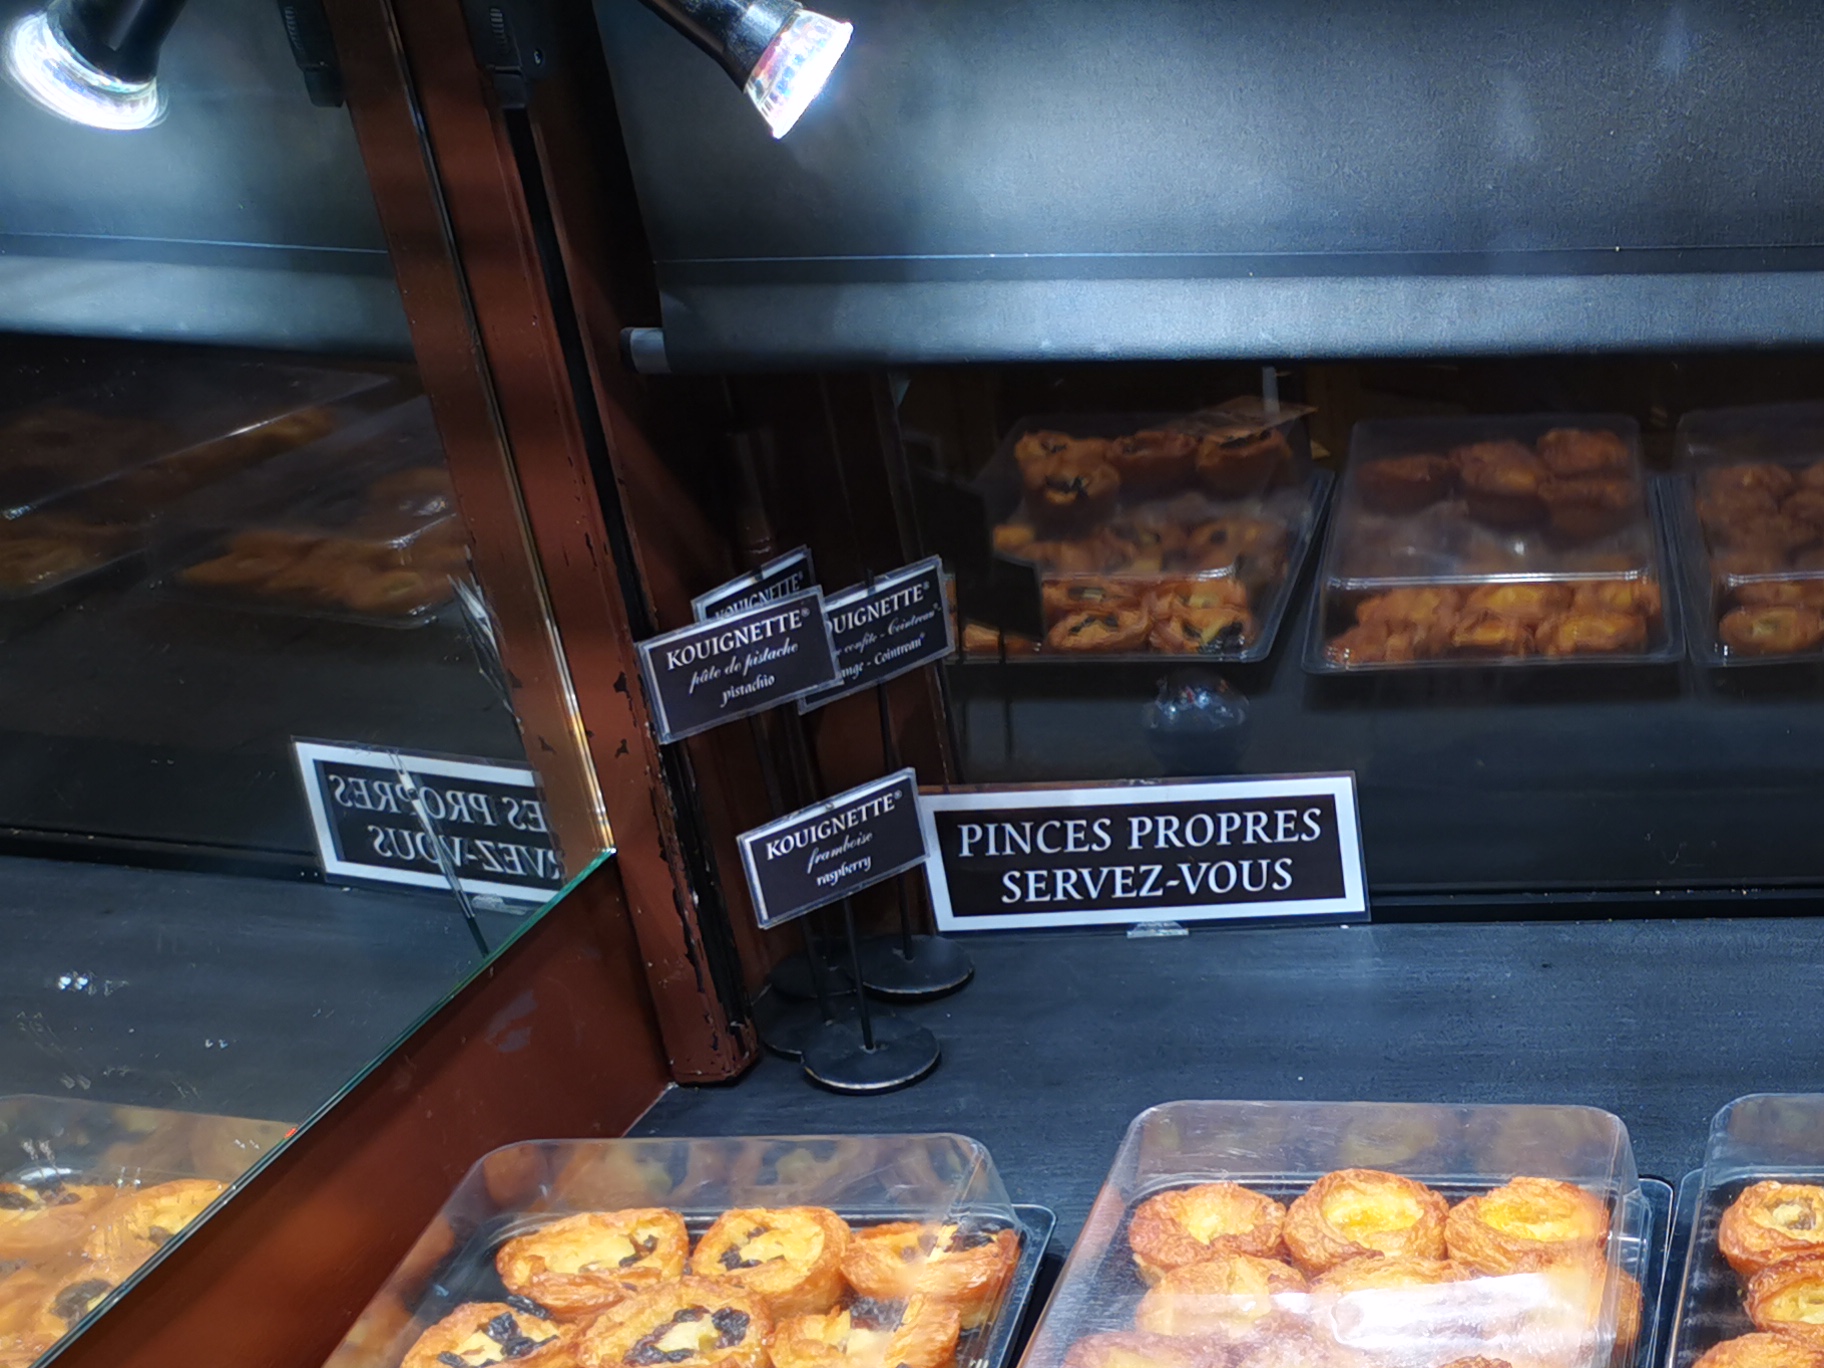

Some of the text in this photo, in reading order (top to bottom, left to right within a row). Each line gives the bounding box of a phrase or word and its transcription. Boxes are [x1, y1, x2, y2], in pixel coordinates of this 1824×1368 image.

[688, 637, 799, 695] pâte de pistache
[720, 674, 775, 708] pistachio
[806, 831, 873, 875] framboise
[957, 808, 1322, 858] PINCES PROPRES
[816, 856, 871, 887] raspberry
[1000, 857, 1294, 904] SERVEZ-VOUS
